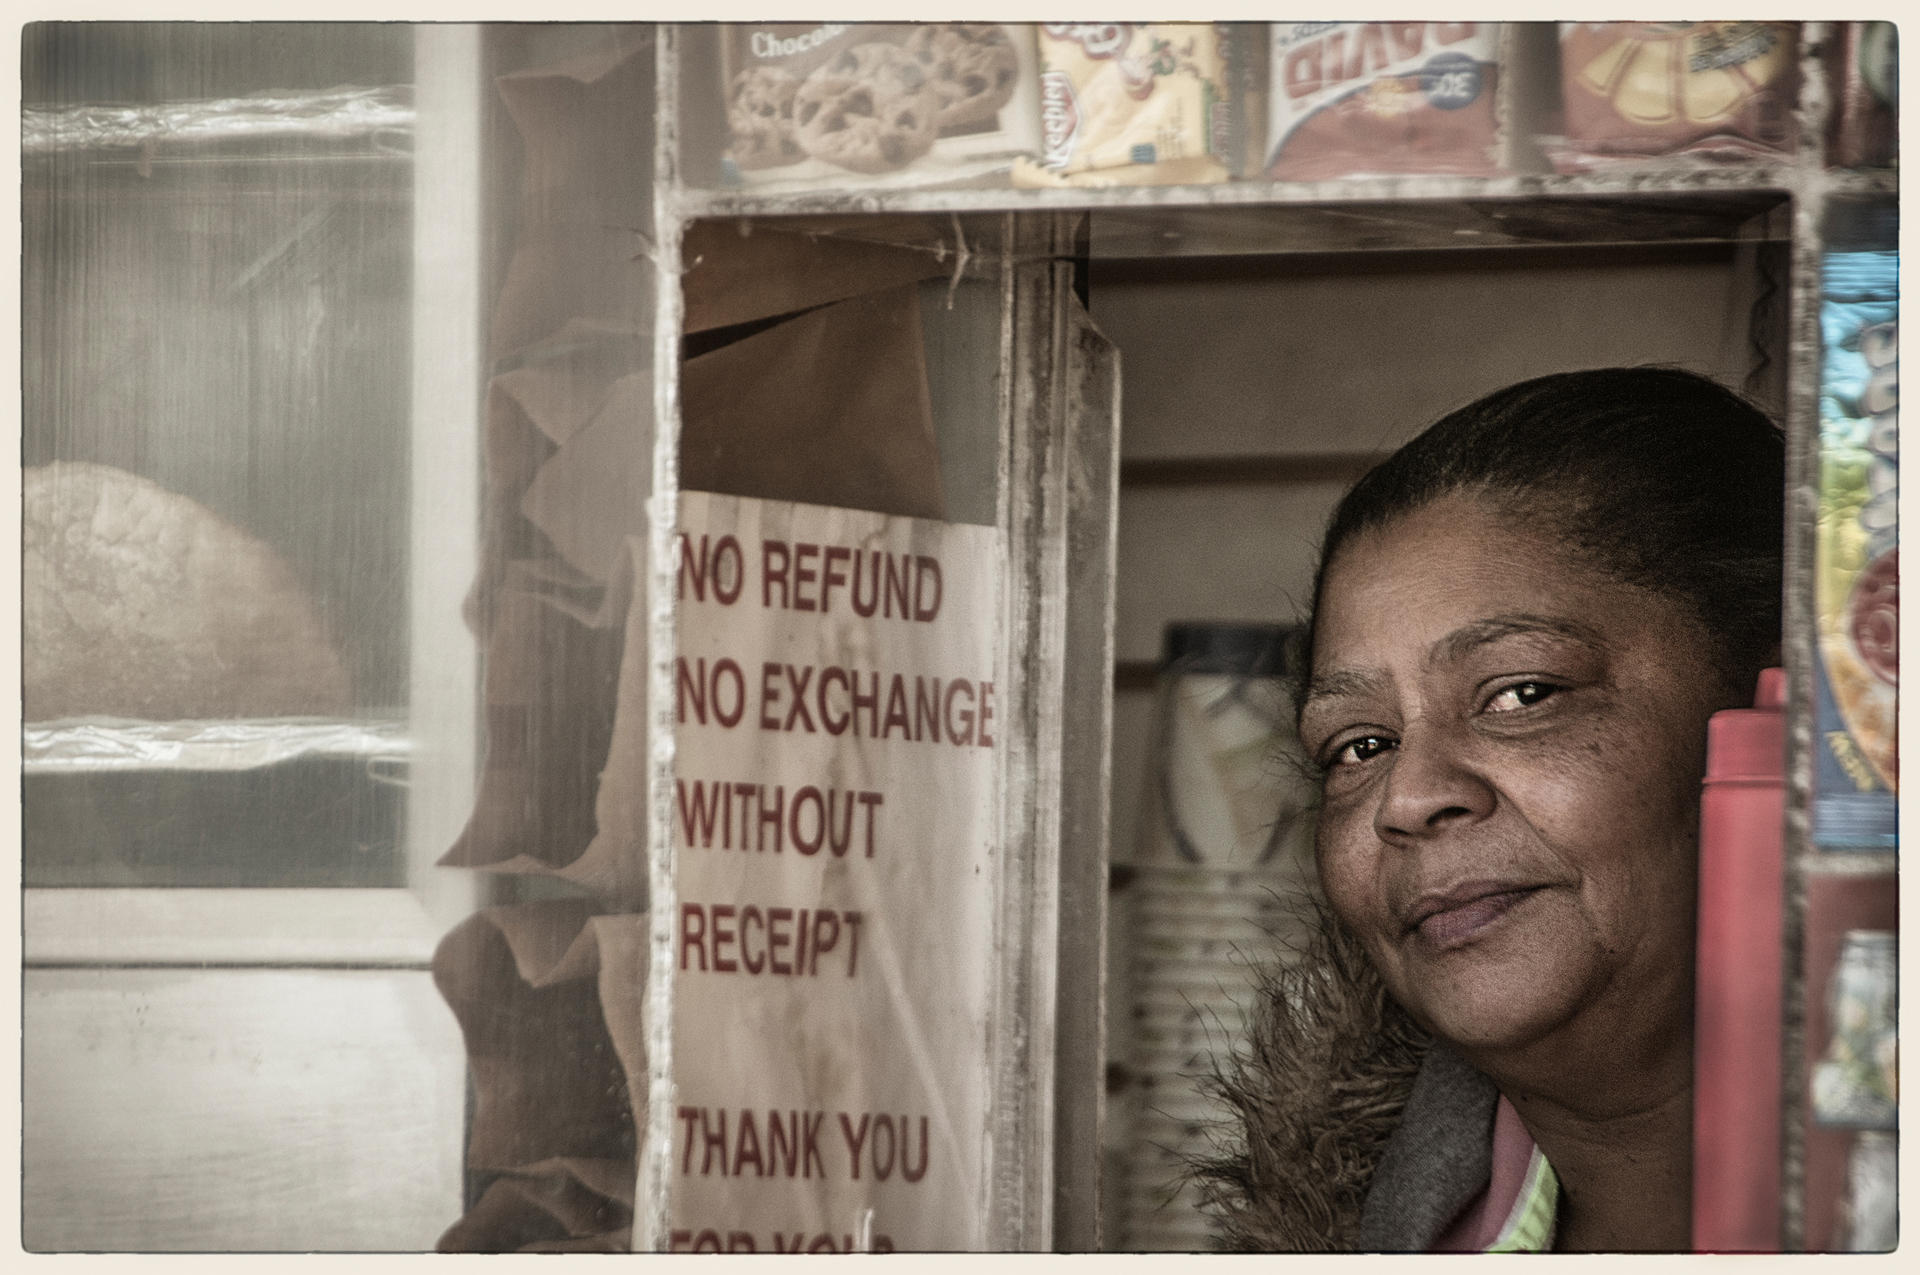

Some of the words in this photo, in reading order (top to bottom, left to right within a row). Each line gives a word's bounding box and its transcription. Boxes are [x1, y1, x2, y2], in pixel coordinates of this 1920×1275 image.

[678, 532, 744, 606] NO
[761, 539, 943, 623] REFUND
[677, 656, 745, 729] NO
[760, 661, 994, 748] EXCHANGE
[677, 778, 884, 859] WITHOUT
[680, 902, 865, 978] RECEIPT
[677, 1106, 827, 1180] THANK
[838, 1112, 930, 1184] YOU
